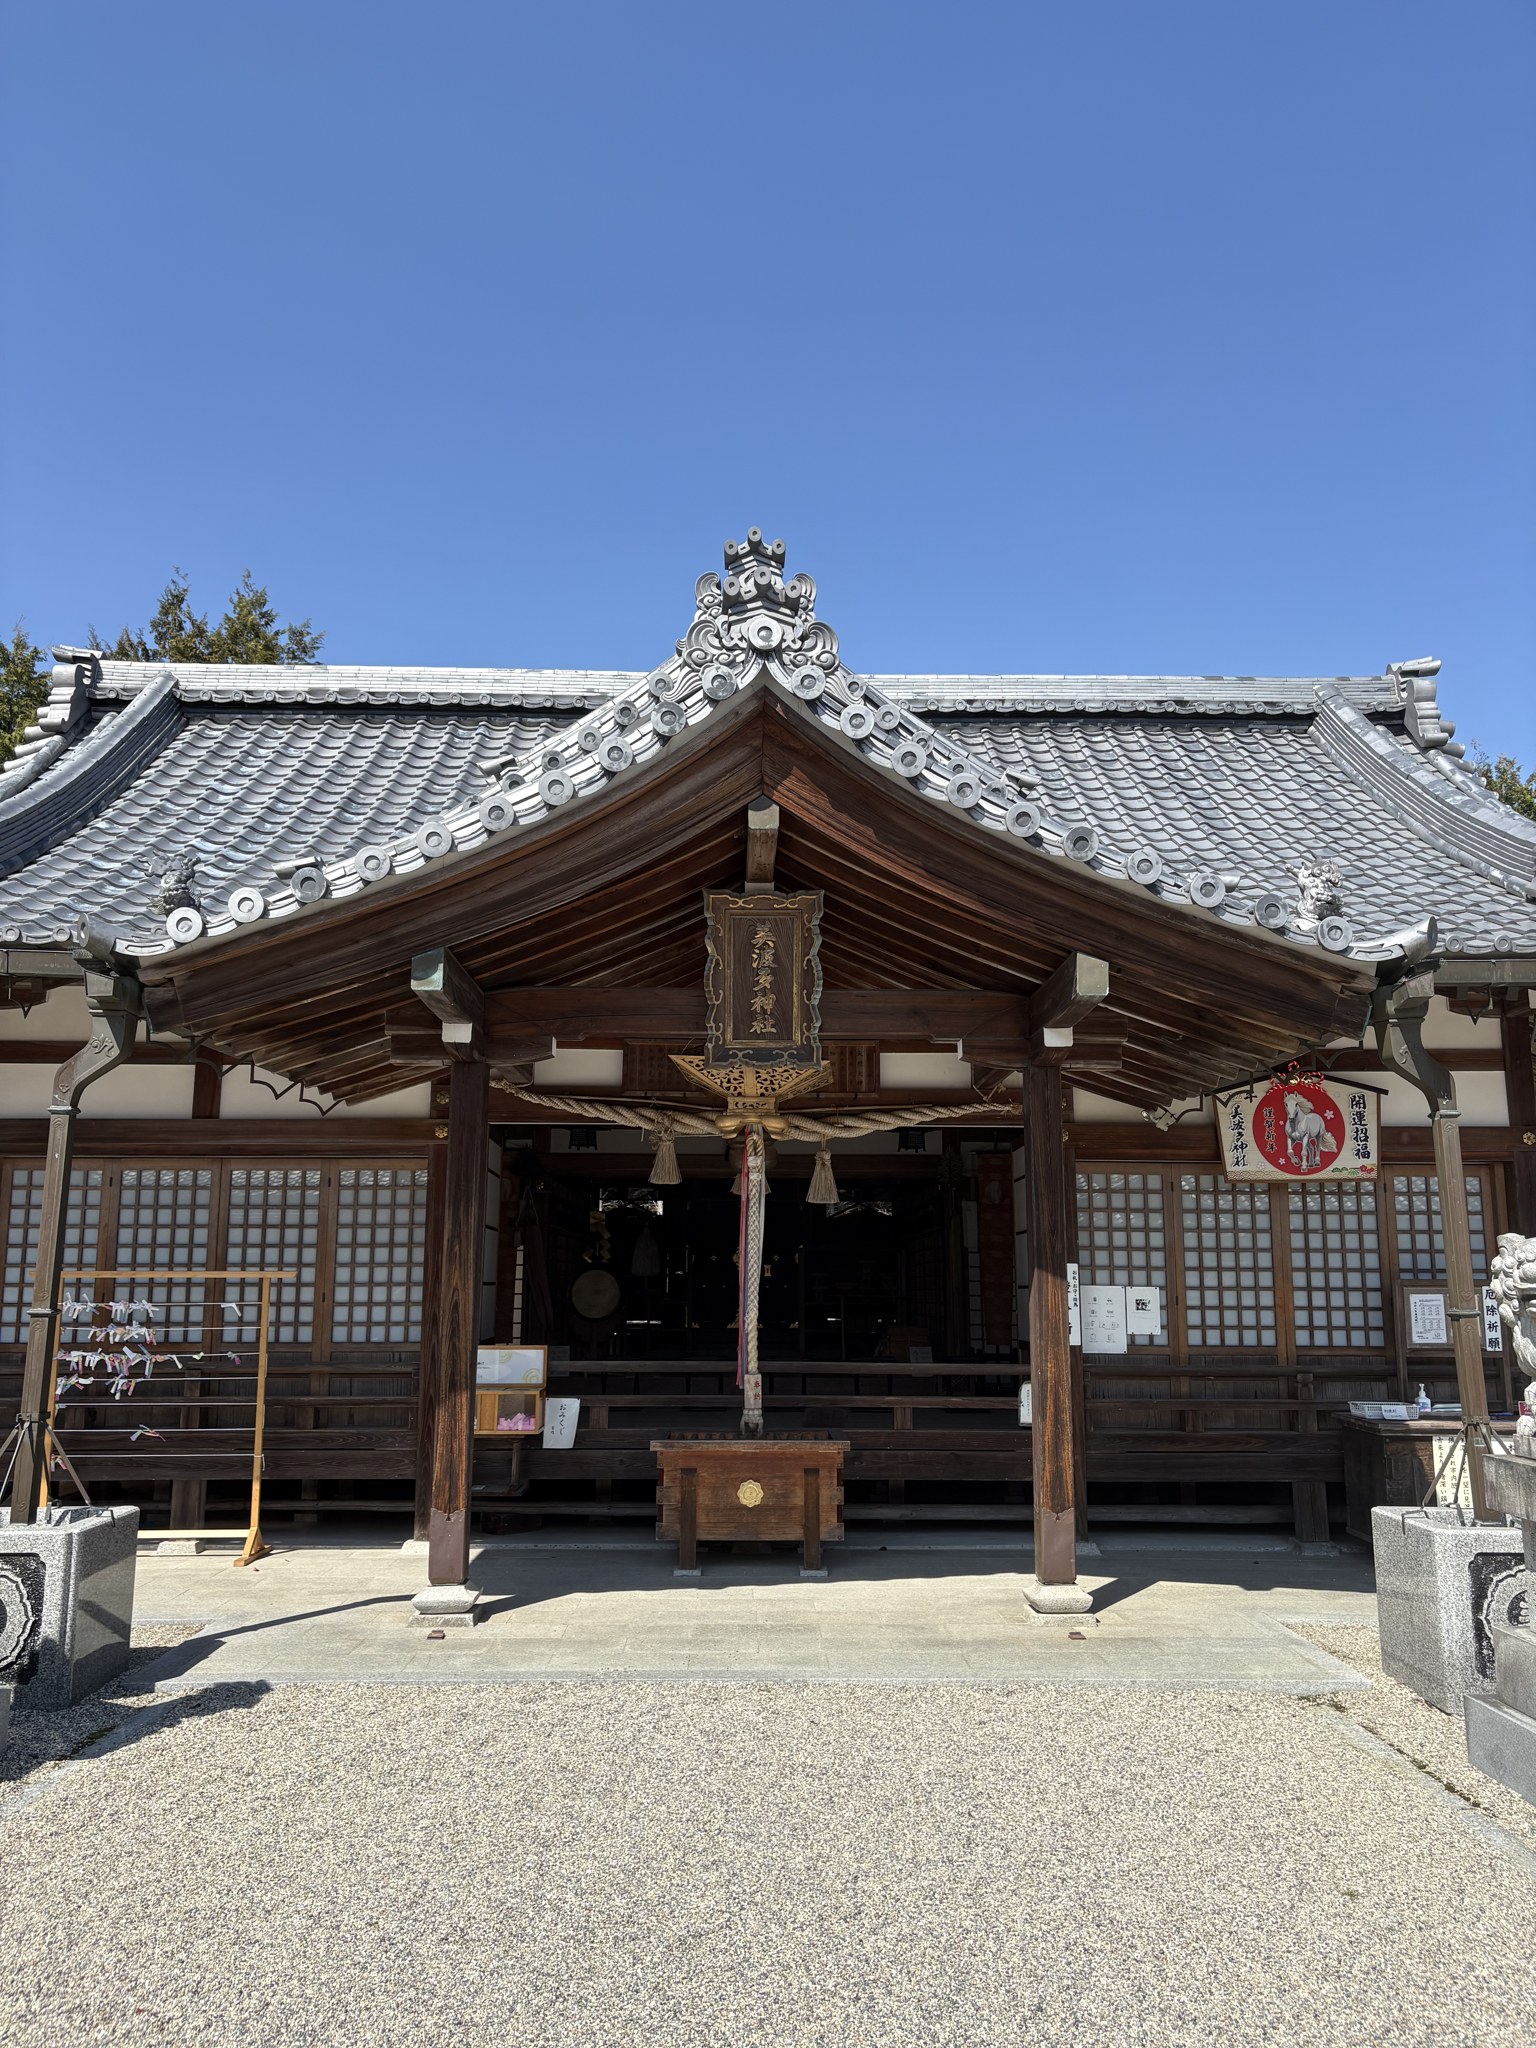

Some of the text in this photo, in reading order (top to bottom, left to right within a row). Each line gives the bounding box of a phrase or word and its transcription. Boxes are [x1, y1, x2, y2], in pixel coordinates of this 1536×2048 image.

[750, 923, 779, 1034] 美波多神社
[1231, 1104, 1249, 1168] 美波多神社
[1264, 1107, 1277, 1154] 謹賀新年
[1349, 1093, 1371, 1160] 開運招福
[1484, 1288, 1501, 1350] 厄除祈願
[558, 1403, 567, 1436] おみくじ
